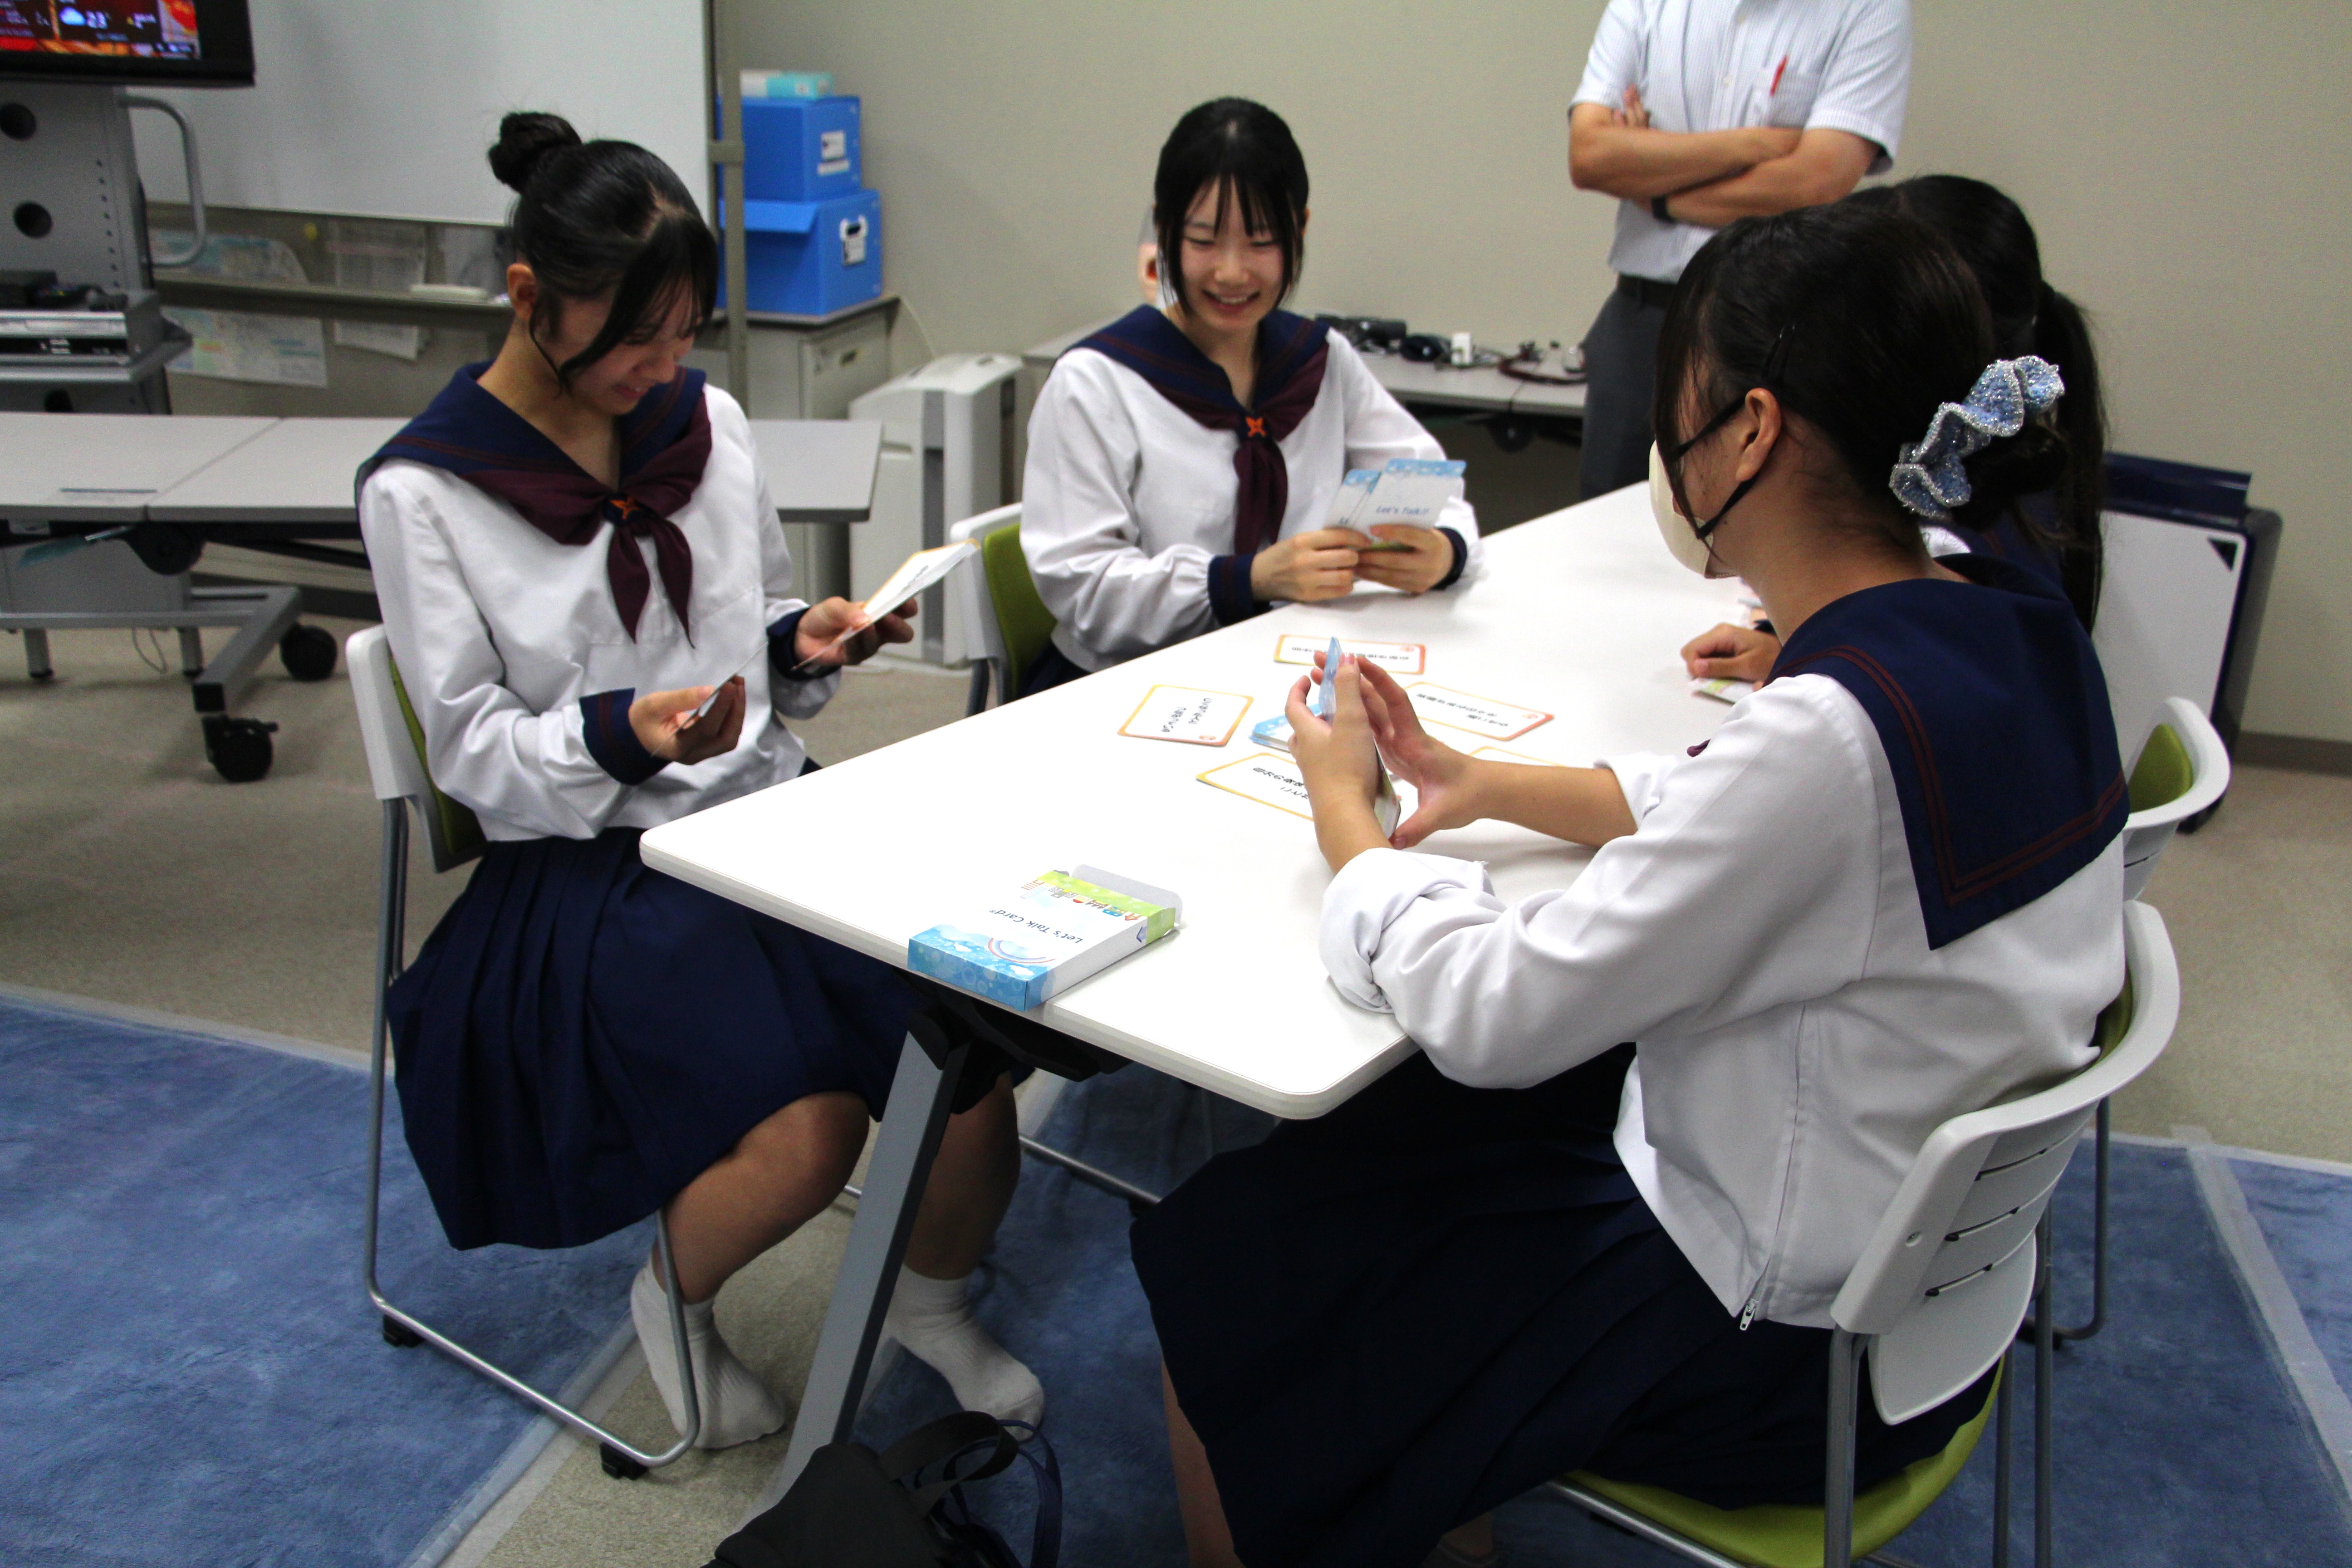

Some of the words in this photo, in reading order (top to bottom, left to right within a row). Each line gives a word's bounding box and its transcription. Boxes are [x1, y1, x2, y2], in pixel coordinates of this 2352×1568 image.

[1376, 505, 1398, 514] Let's
[1026, 921, 1050, 933] Talk
[1053, 931, 1083, 943] Let's
